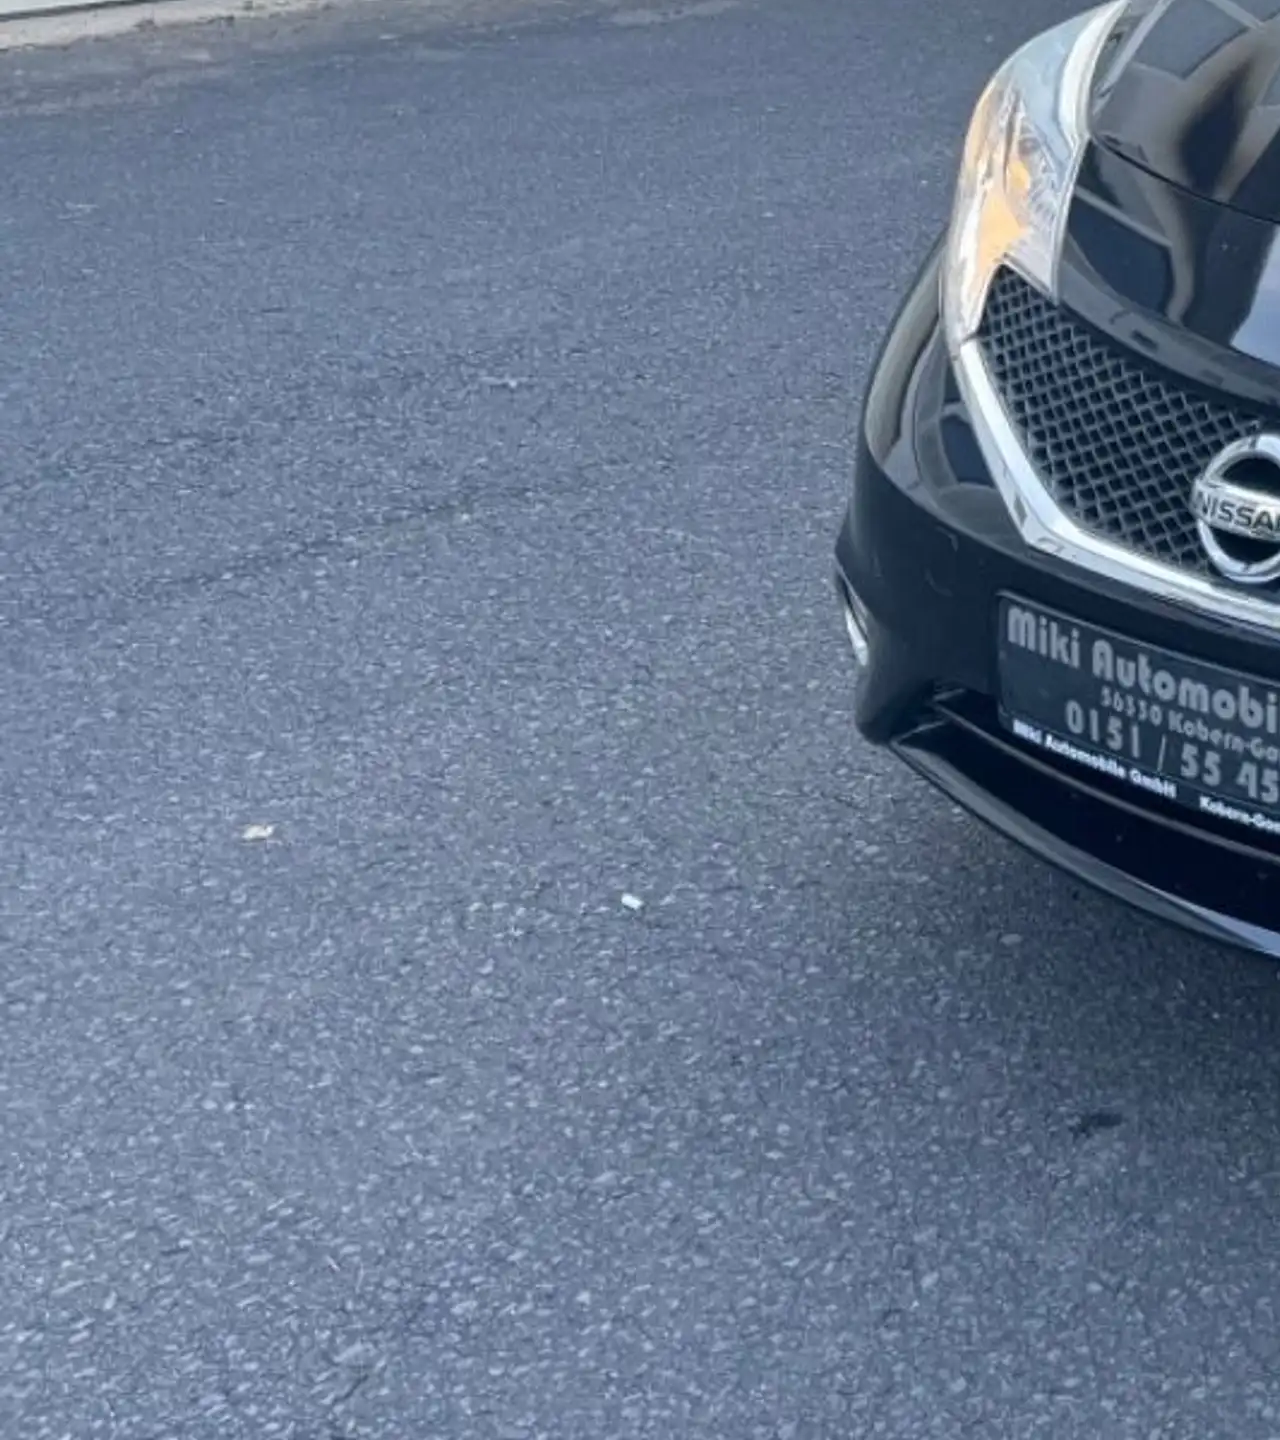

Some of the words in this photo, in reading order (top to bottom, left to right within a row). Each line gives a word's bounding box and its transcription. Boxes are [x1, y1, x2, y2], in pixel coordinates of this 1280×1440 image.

[1008, 606, 1080, 669] Miki
[1065, 700, 1142, 759] 0151
[1180, 742, 1221, 787] 55
[1236, 760, 1280, 804] 45
